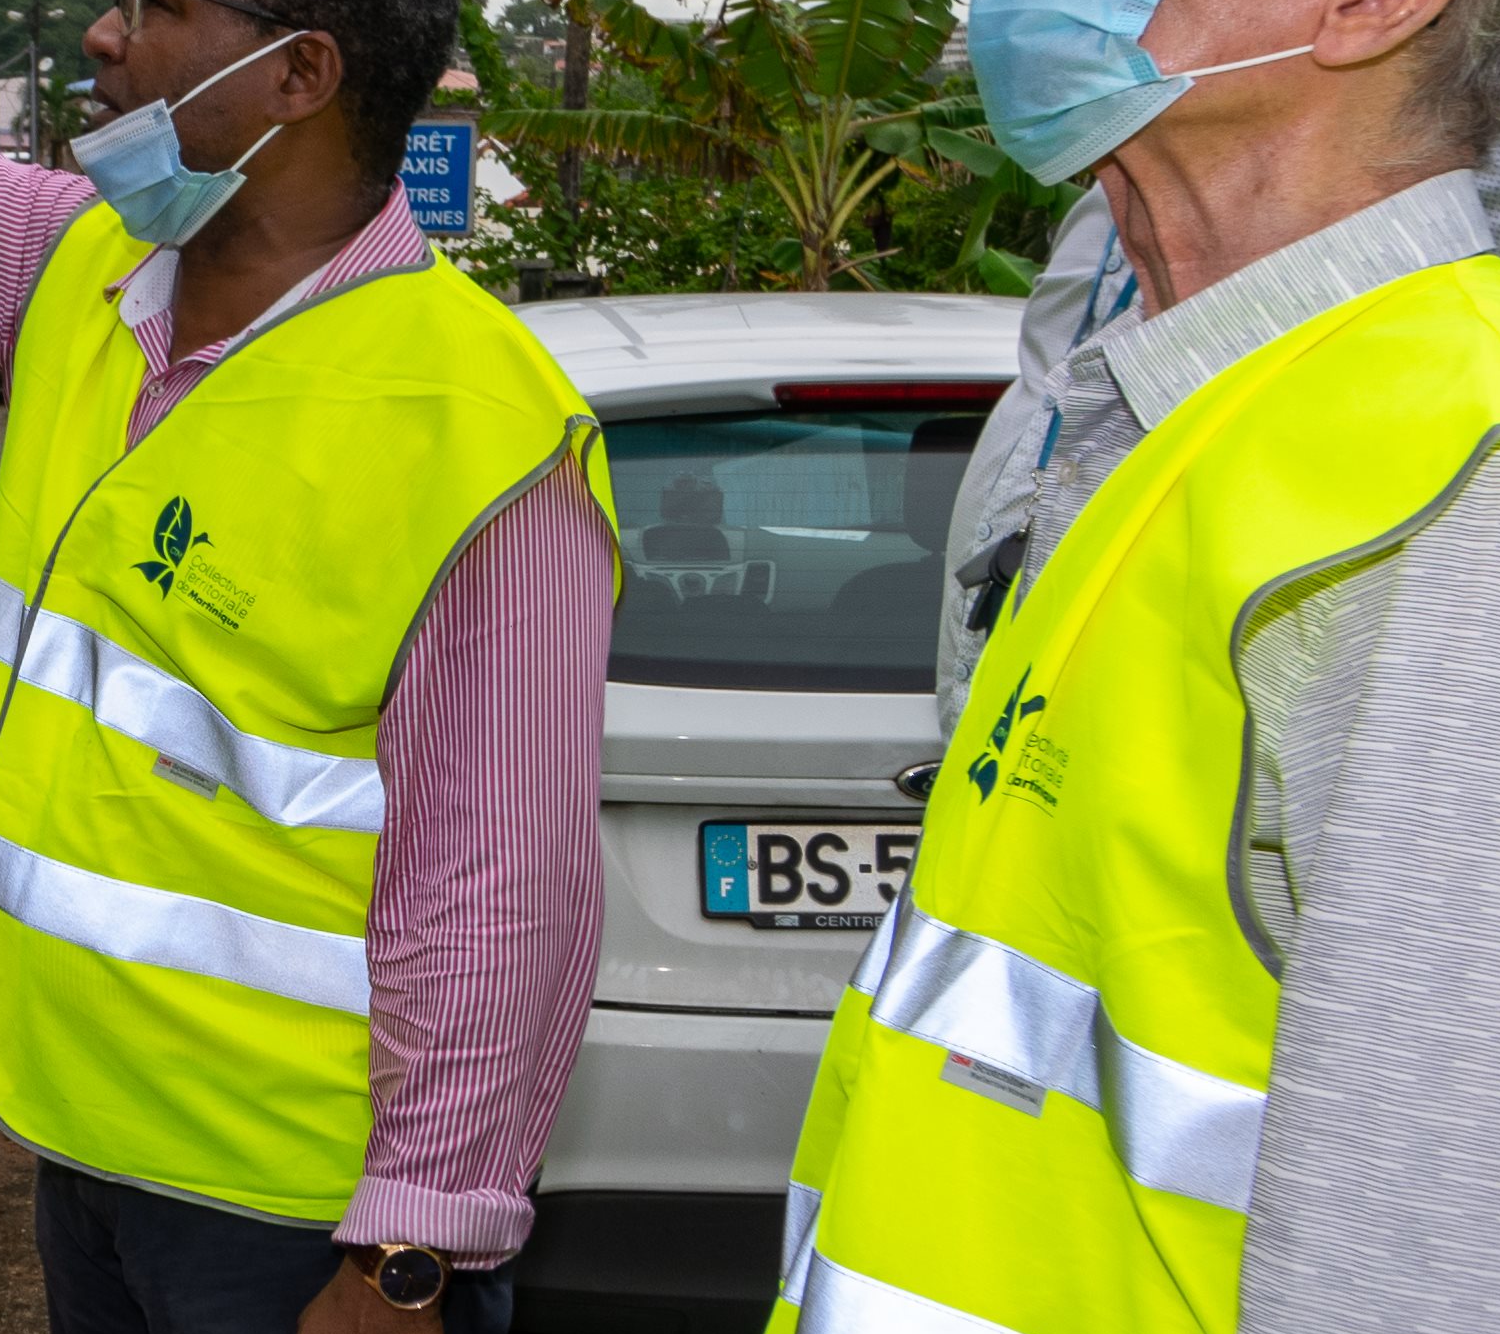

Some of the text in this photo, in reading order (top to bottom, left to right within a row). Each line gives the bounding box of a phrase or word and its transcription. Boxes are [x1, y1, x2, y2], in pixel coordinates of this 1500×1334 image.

[406, 131, 457, 153] RÊT
[401, 157, 450, 175] AXIS
[407, 188, 450, 203] TRES
[414, 210, 466, 226] UNES
[191, 554, 257, 607] Collectivité
[184, 564, 249, 620] Territoriale
[176, 579, 240, 630] de Martinique
[720, 877, 735, 898] F
